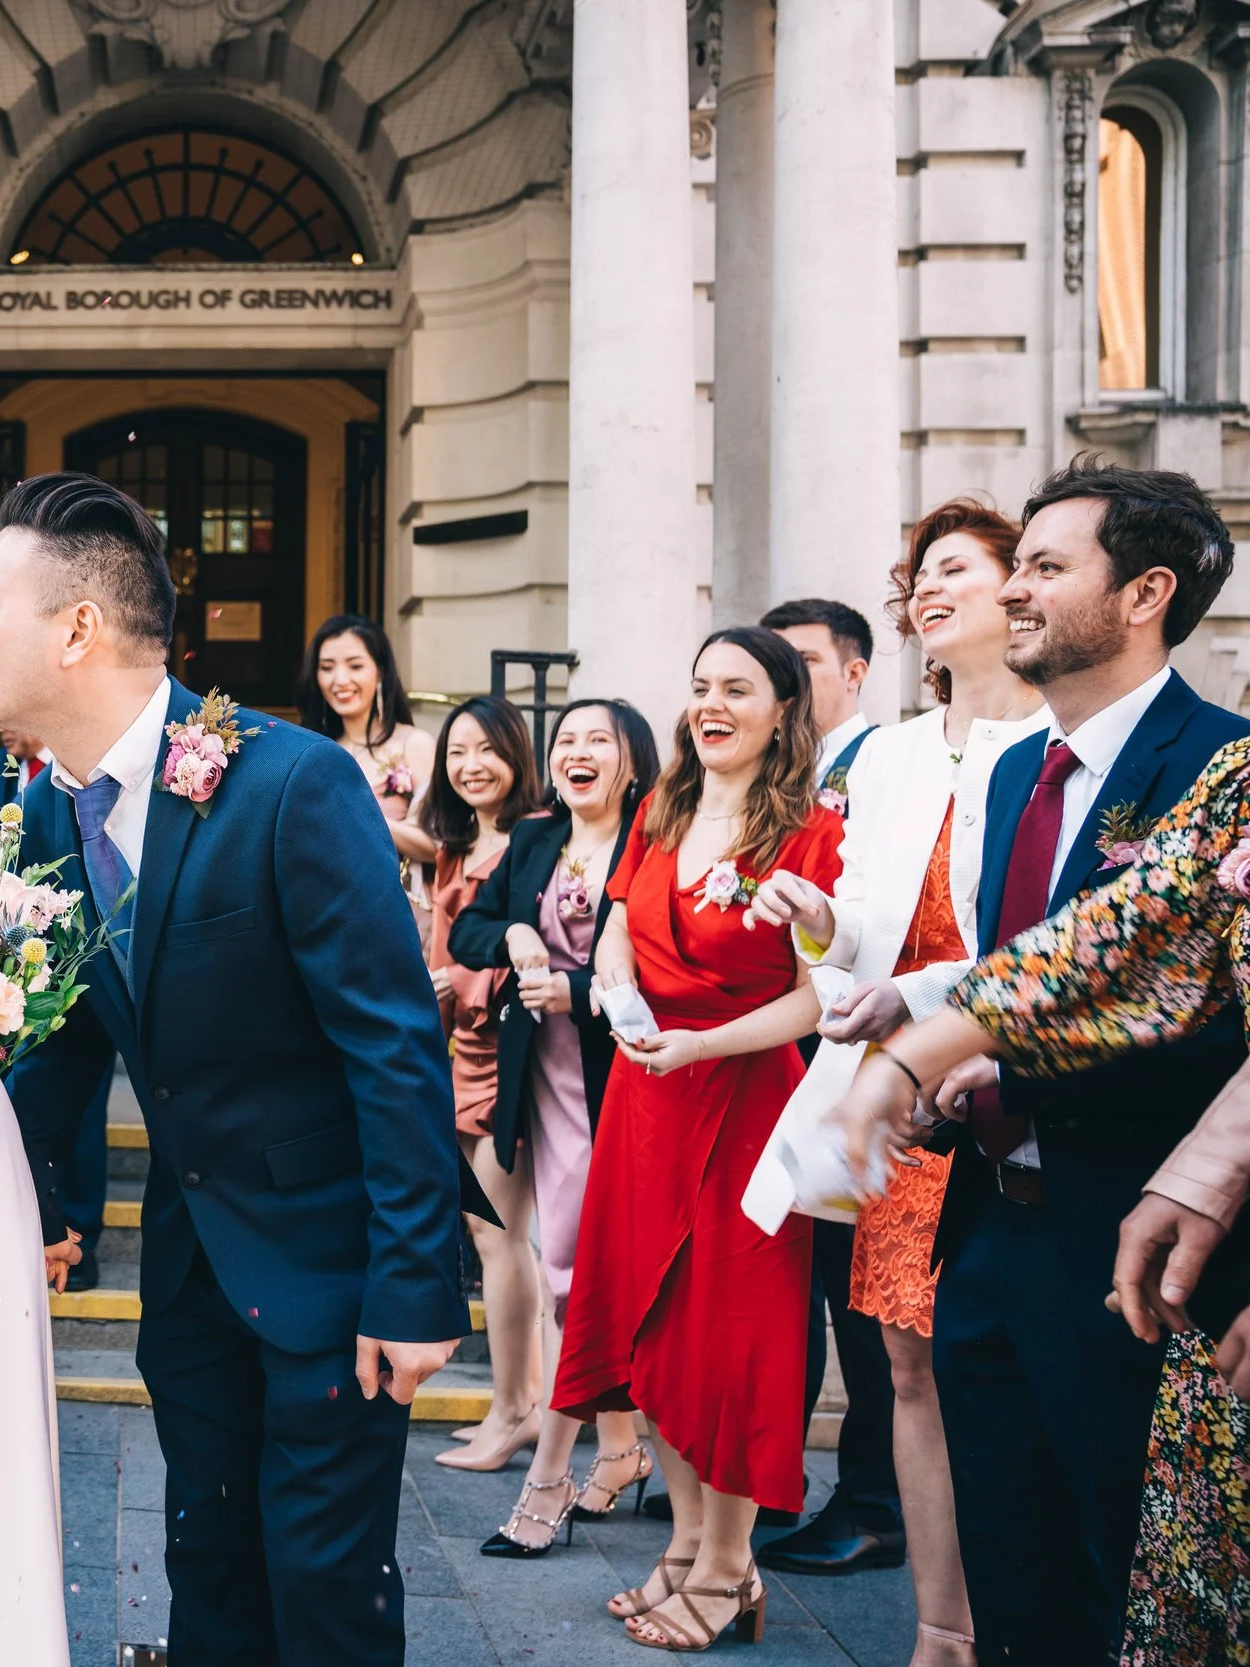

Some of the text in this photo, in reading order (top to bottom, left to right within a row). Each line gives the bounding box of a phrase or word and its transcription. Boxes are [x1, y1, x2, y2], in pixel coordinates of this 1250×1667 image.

[65, 290, 191, 310] BOROUGH
[198, 289, 232, 309] OF
[239, 289, 392, 310] GREENWICH
